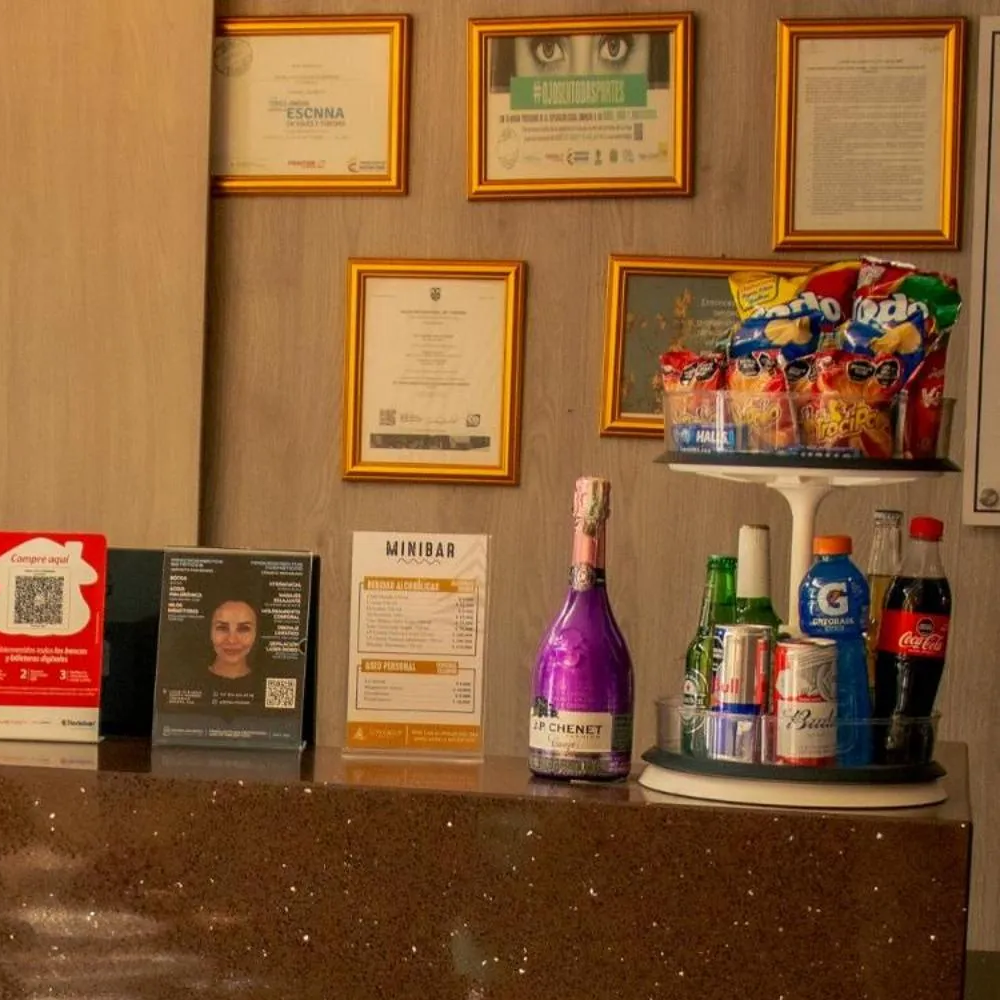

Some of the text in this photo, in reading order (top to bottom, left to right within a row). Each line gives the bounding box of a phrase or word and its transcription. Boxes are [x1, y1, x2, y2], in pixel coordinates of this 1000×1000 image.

[286, 106, 345, 120] ESCNNA
[695, 429, 729, 443] HALS
[385, 540, 455, 558] MINIBAR
[10, 553, 47, 565] Compre
[20, 669, 27, 679] 2
[59, 669, 66, 680] 3
[548, 722, 603, 735] CHENET
